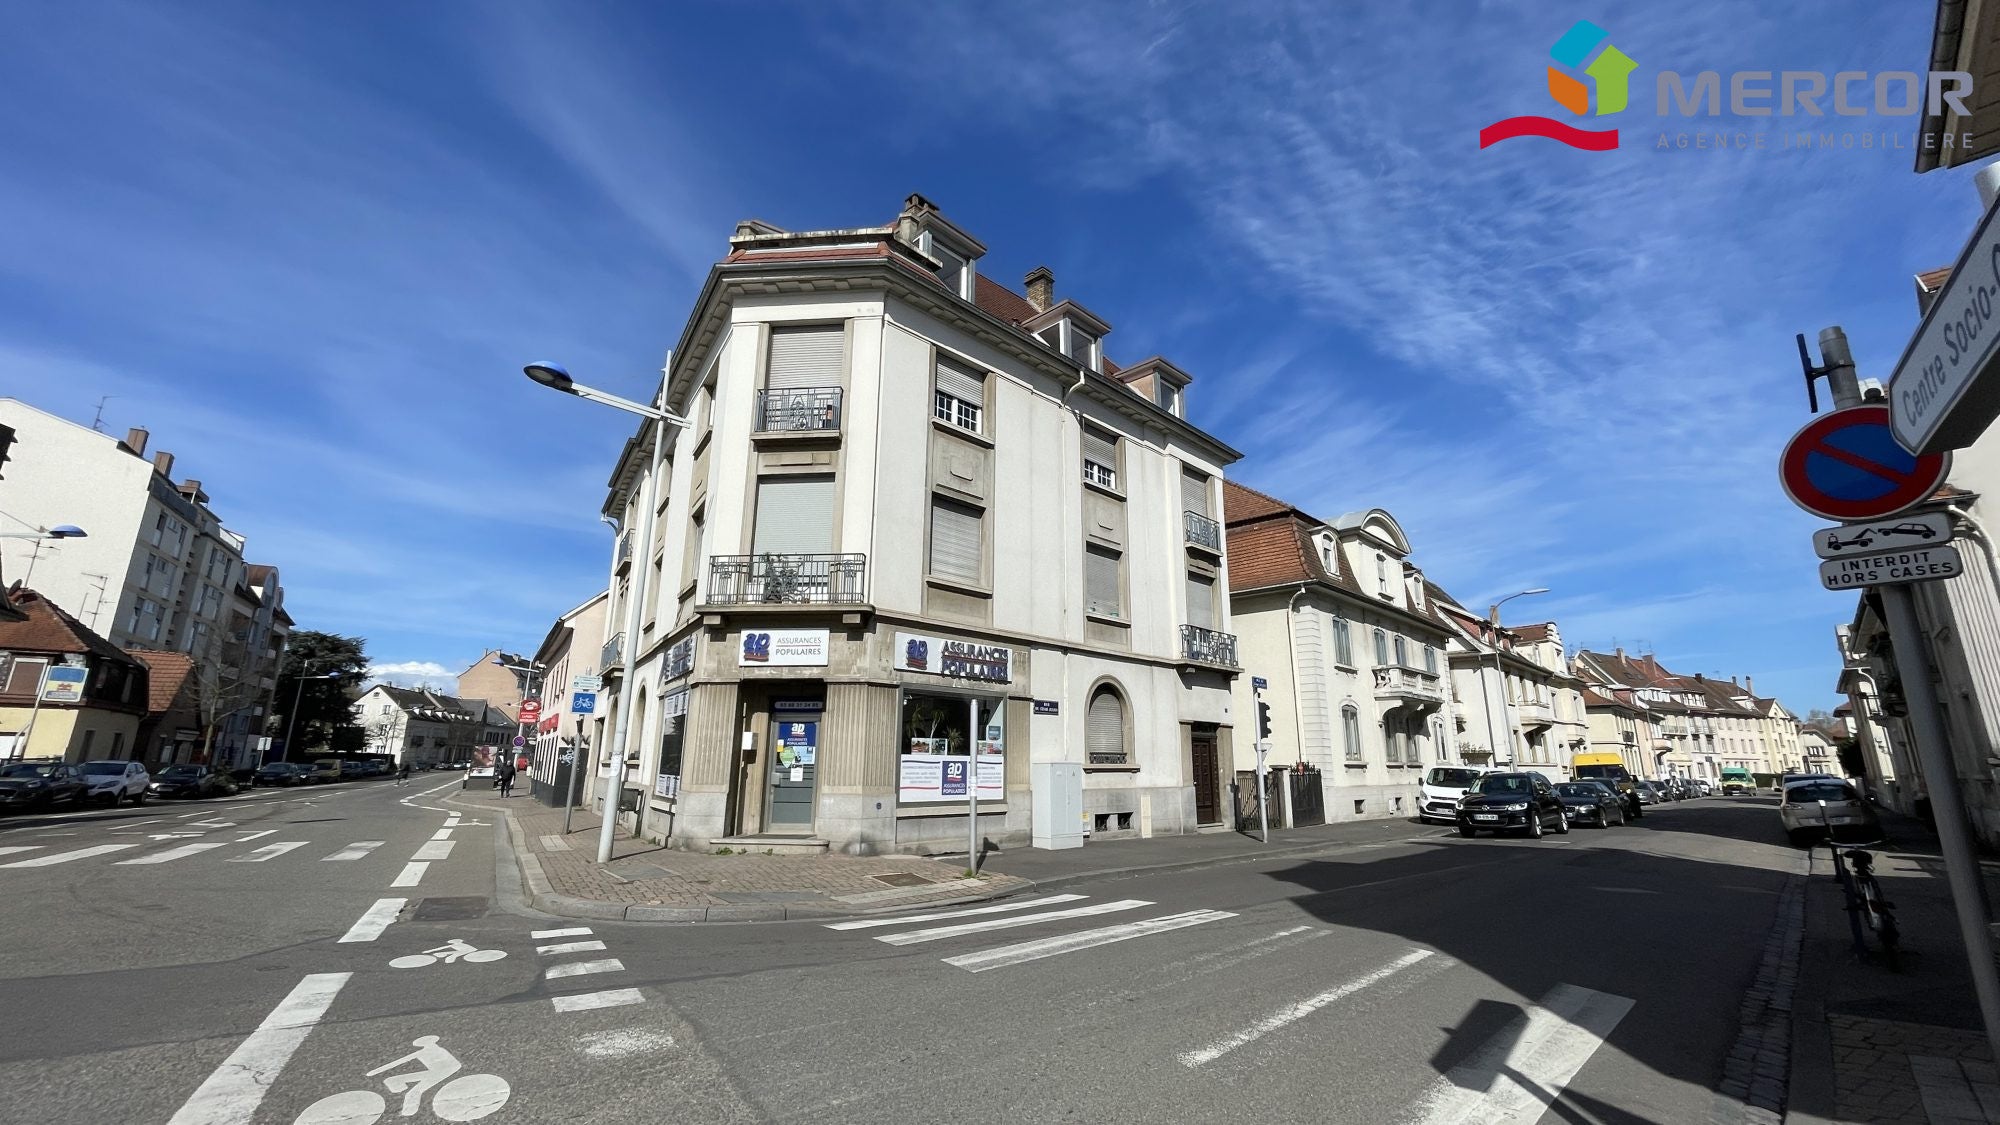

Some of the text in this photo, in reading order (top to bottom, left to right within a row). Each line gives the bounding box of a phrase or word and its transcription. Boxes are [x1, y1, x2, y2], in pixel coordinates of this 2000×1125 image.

[1902, 354, 1946, 428] Centre
[1841, 551, 1931, 572] INTERDIT
[1827, 562, 1954, 586] HORS CASES
[776, 636, 822, 645] ASSURANCES
[941, 640, 1009, 660] ASSURANCES
[775, 648, 822, 656] POPULAIRES
[941, 659, 1009, 682] POPULAIRES
[791, 723, 805, 734] ap
[947, 762, 963, 778] ap
